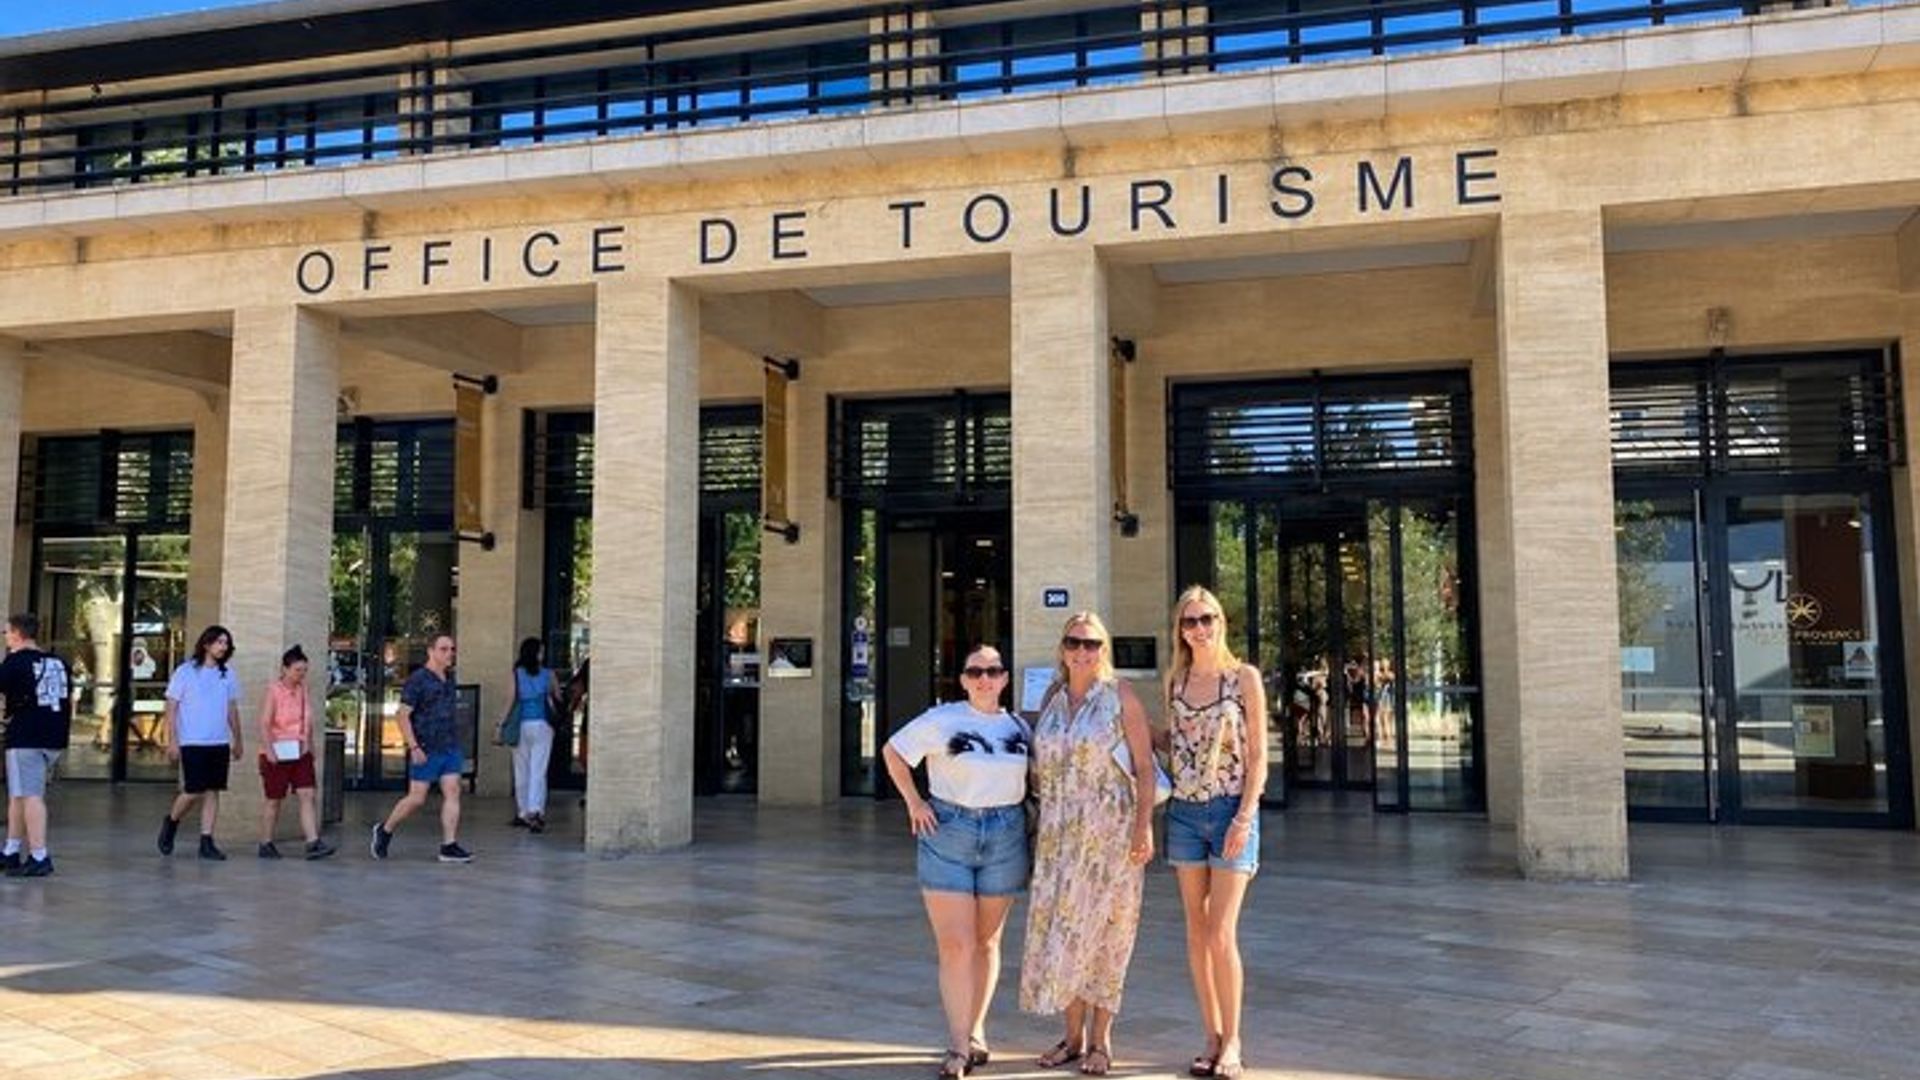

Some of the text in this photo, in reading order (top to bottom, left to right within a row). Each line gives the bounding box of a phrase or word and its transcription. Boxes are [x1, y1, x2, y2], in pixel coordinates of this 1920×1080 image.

[297, 149, 1503, 294] OFFICE DE TOURISME
